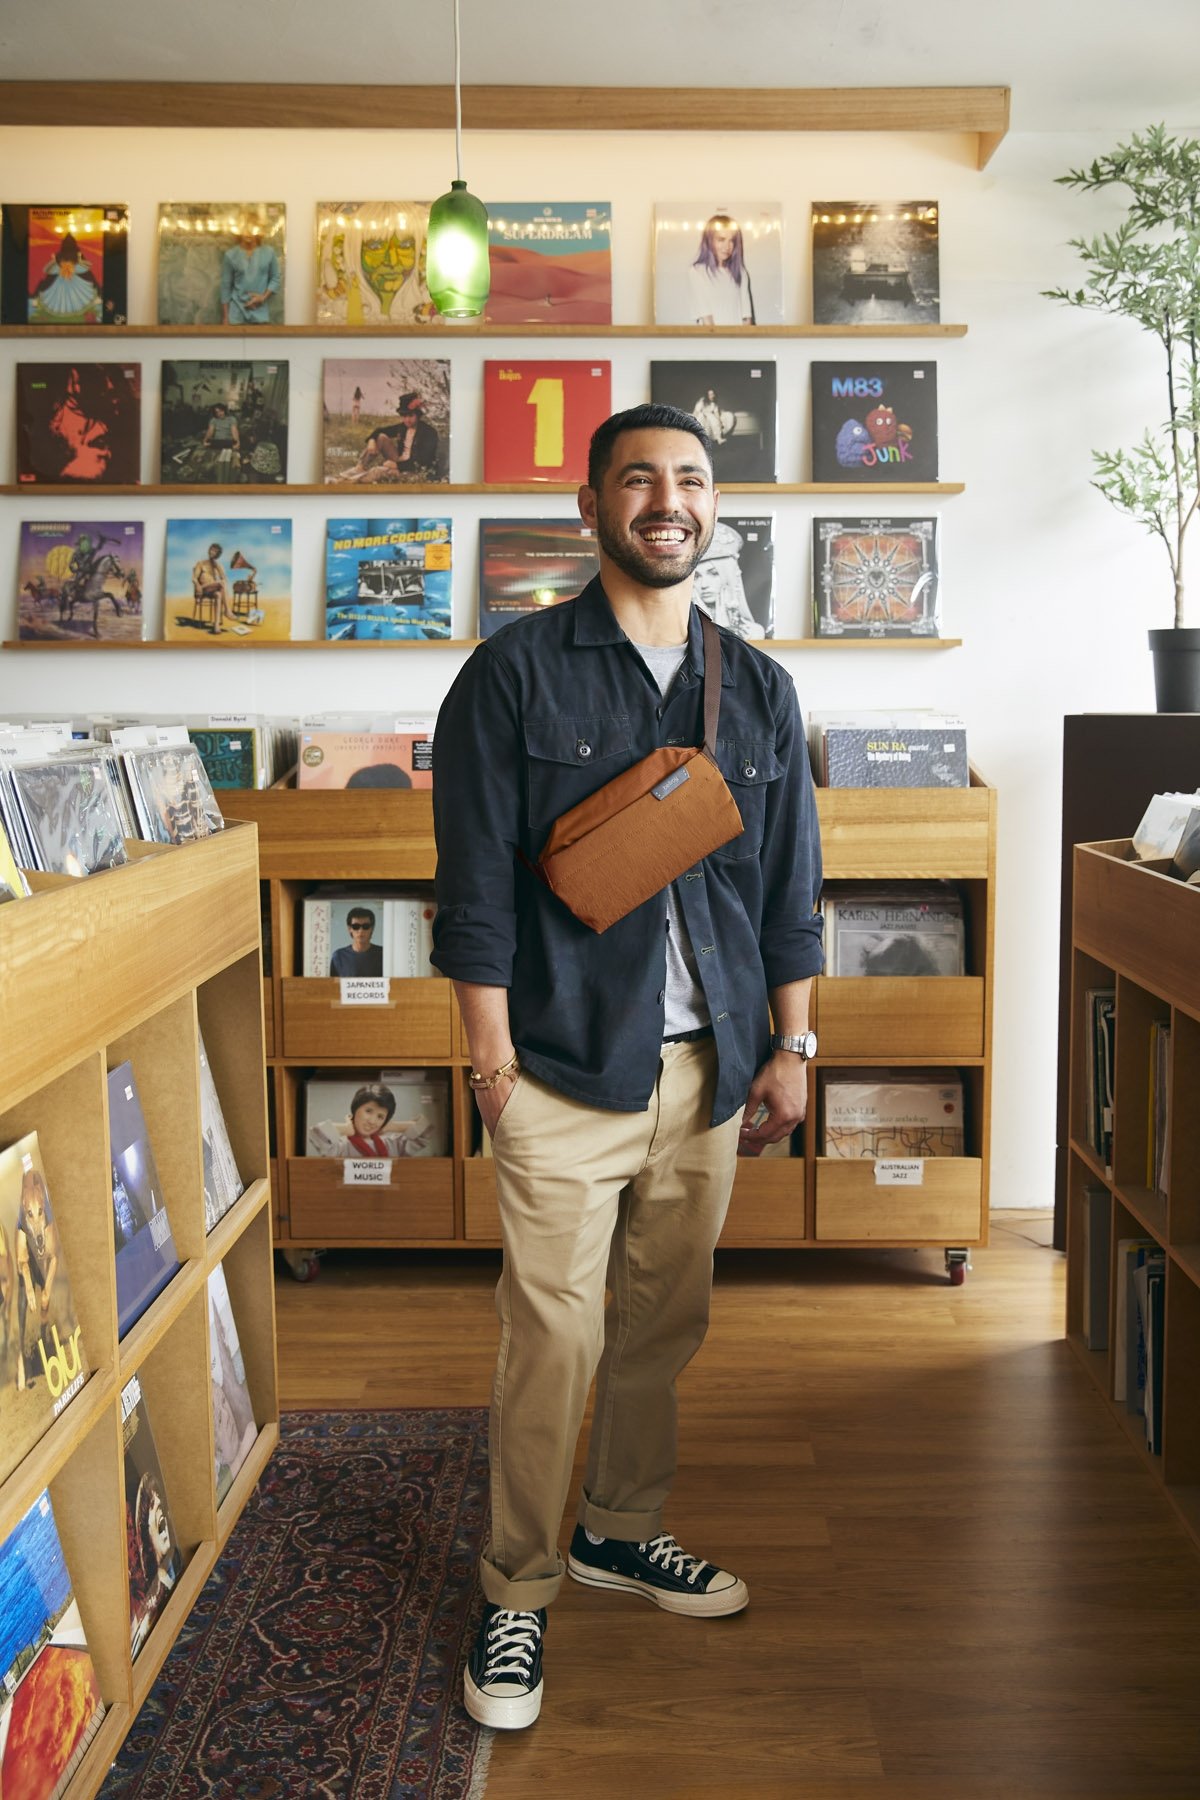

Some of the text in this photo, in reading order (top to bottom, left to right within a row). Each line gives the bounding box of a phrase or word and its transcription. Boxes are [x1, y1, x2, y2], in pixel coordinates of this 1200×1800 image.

[831, 377, 883, 397] M83
[526, 378, 565, 467] 1
[863, 439, 913, 466] Junk
[333, 528, 449, 551] NO MORE COCOONS
[233, 715, 247, 723] Byrd
[867, 741, 890, 751] SUN
[891, 741, 907, 751] RA
[838, 909, 960, 923] KAREN HERNANDEZ
[346, 981, 385, 989] JAPANESE
[352, 1161, 385, 1170] WORLD
[354, 1173, 384, 1181] MUSIC
[38, 1324, 82, 1397] blur
[53, 1371, 86, 1417] PARKLIFE
